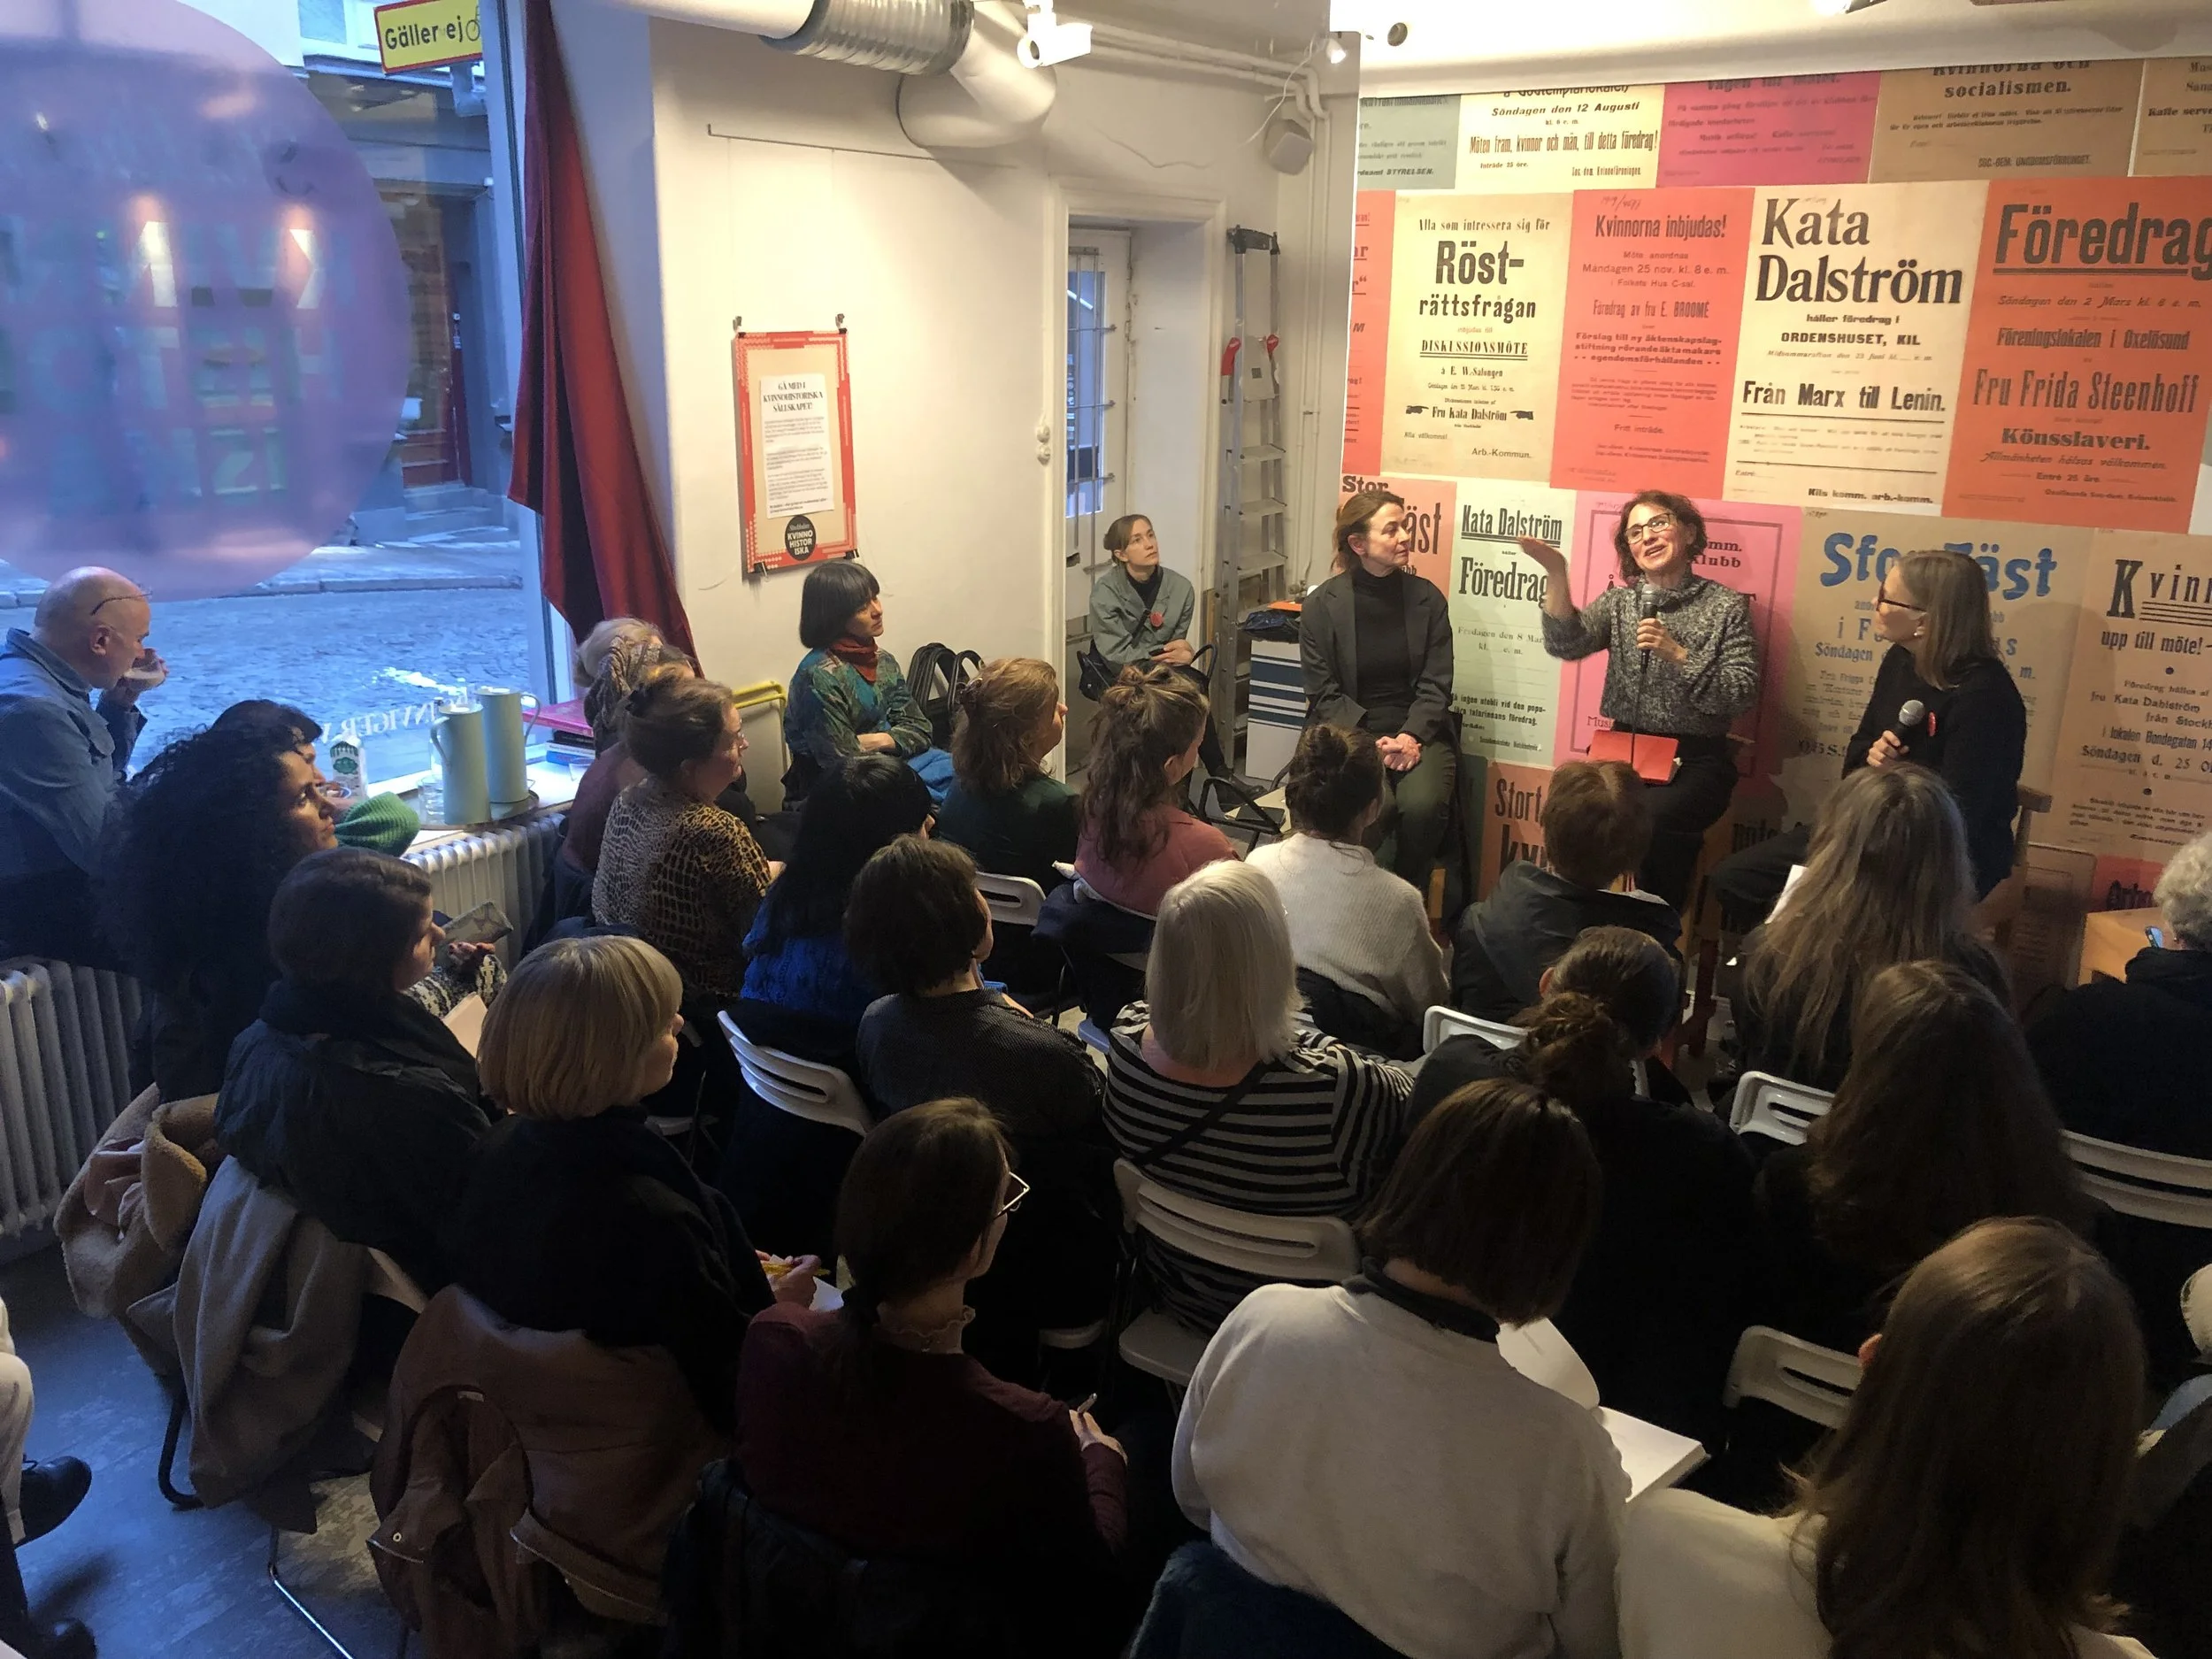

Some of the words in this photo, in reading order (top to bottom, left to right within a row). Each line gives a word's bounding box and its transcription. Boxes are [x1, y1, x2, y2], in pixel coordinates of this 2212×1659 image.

[385, 24, 439, 50] Gäller
[446, 15, 464, 42] ej
[1944, 79, 2071, 99] socialismen.
[1491, 105, 1546, 117] Söndagen
[1550, 103, 1572, 113] den
[1577, 103, 1589, 112] 12
[1594, 101, 1640, 113] Augusti
[1469, 135, 1491, 154] Möten
[1494, 134, 1513, 153] fram,
[1517, 134, 1543, 152] kvinnor
[1547, 133, 1559, 151] och
[1563, 132, 1579, 151] män,
[1584, 131, 1594, 150] till
[1598, 131, 1617, 150] detta
[1621, 129, 1659, 151] föredrag!
[1440, 219, 1459, 231] som
[1463, 219, 1512, 231] intressera
[1517, 219, 1531, 234] sig
[1535, 218, 1550, 231] för
[1595, 214, 1660, 238] Kvinnorna
[1665, 214, 1727, 242] inbjudas!
[1761, 197, 1870, 250] Kata
[1994, 202, 2212, 281] Föredrag
[1435, 240, 1525, 285] Röst-
[1637, 265, 1651, 273] 25
[1654, 265, 1676, 274] nov.
[1678, 265, 1691, 274] kl.
[1755, 254, 1963, 304] Dalström
[1419, 293, 1536, 325] rättsfrågan
[1593, 299, 1625, 319] Föredrag
[1997, 295, 2051, 308] Söndagen
[2057, 296, 2078, 306] den
[2083, 296, 2092, 306] 2
[1805, 313, 1839, 324] håller
[1842, 314, 1892, 326] föredrag
[1576, 332, 1613, 342] Förslag
[1780, 331, 1887, 347] ORDENSHUSET,
[1575, 343, 1617, 353] stiftning
[1742, 380, 1786, 405] Från
[1797, 382, 1846, 408] Marx
[1859, 385, 1880, 410] till
[1891, 387, 1946, 412] Lenin.
[1972, 368, 2012, 406] Fru
[2020, 369, 2080, 410] Frida
[2087, 370, 2200, 414] Steenhoff
[1432, 406, 1446, 419] Fru
[1449, 407, 1468, 419] Kata
[1471, 408, 1508, 421] Dalström
[2001, 427, 2151, 450] Könsslaveri.
[1471, 447, 1532, 459] Arb.-Kommun.
[1342, 475, 1390, 494] Stor
[1403, 502, 1442, 556] äst
[1461, 504, 1494, 535] Kata
[1498, 507, 1563, 541] Dalström
[787, 530, 813, 541] KVINNO
[789, 538, 812, 549] HISTOR
[795, 547, 810, 556] ISKA
[1458, 557, 1548, 609] Föredrag
[1499, 632, 1514, 641] den
[2101, 631, 2128, 651] upp
[2134, 631, 2155, 650] till
[2160, 634, 2203, 656] möte!
[1815, 641, 1873, 663] Söndagen
[2114, 694, 2139, 706] Kata
[2080, 744, 2141, 764] Söndagen
[2175, 757, 2191, 770] 25
